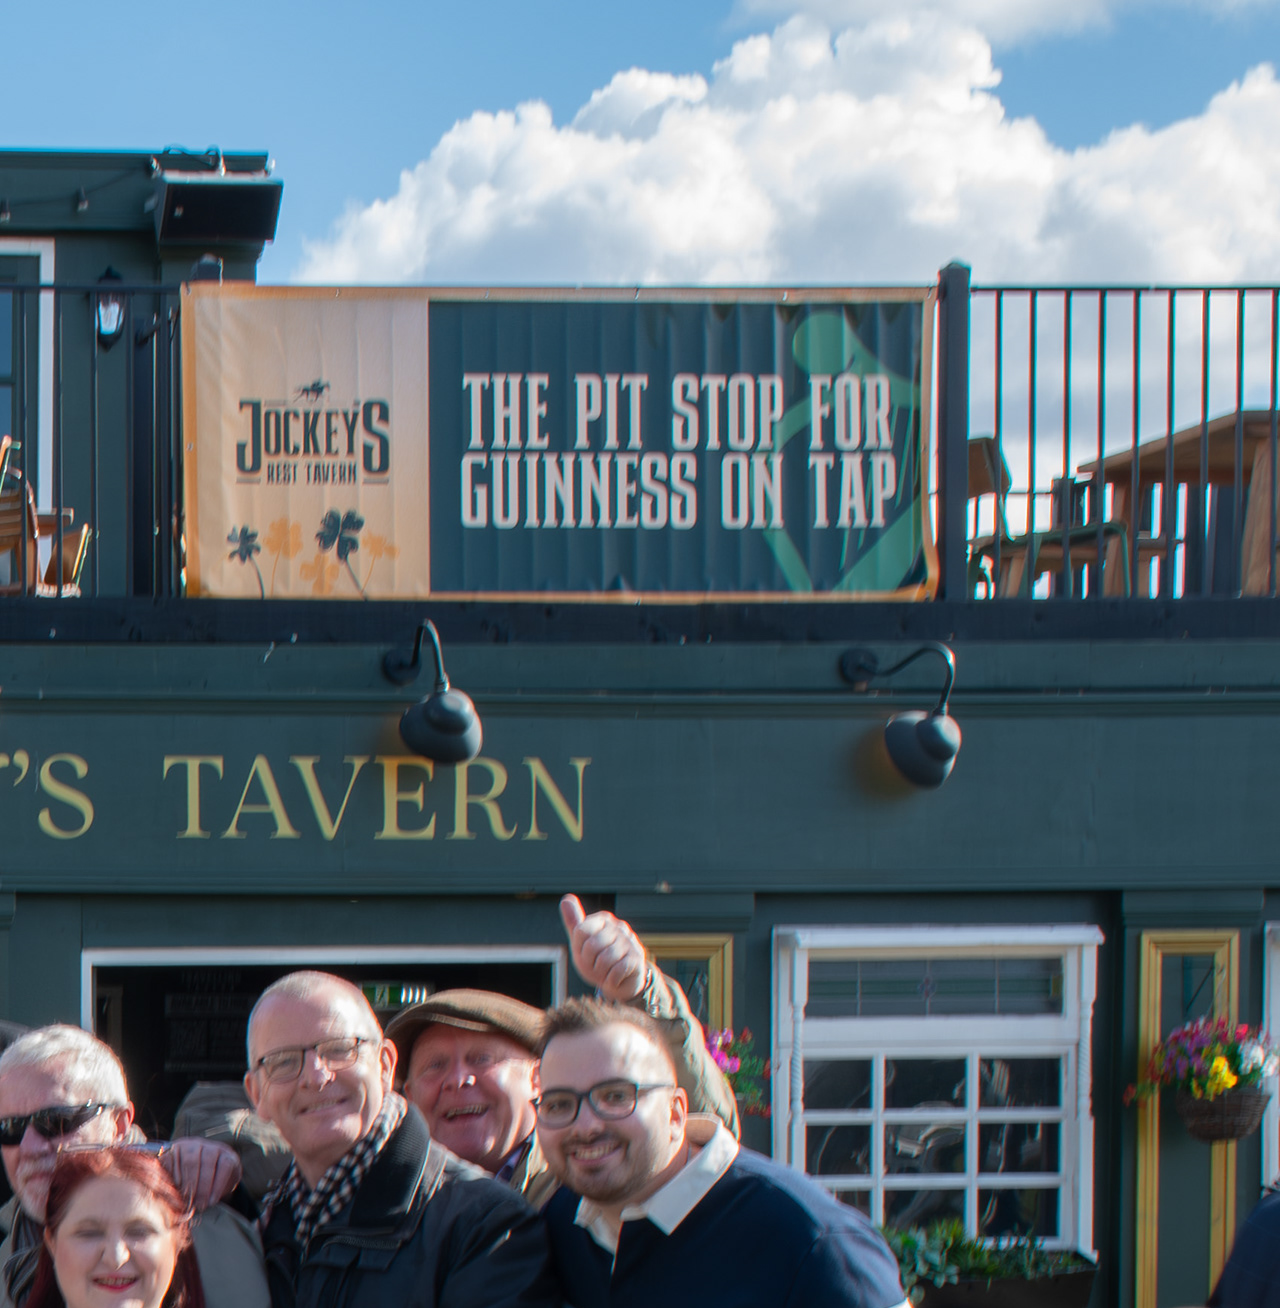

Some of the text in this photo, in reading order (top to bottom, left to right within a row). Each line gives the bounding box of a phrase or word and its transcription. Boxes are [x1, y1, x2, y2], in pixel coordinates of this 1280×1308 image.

[461, 372, 893, 451] THE PIT STOP FOR
[266, 462, 358, 485] REST TAVERN
[460, 451, 897, 530] GUINNESS ON TAP
[162, 753, 592, 842] TAVERN
